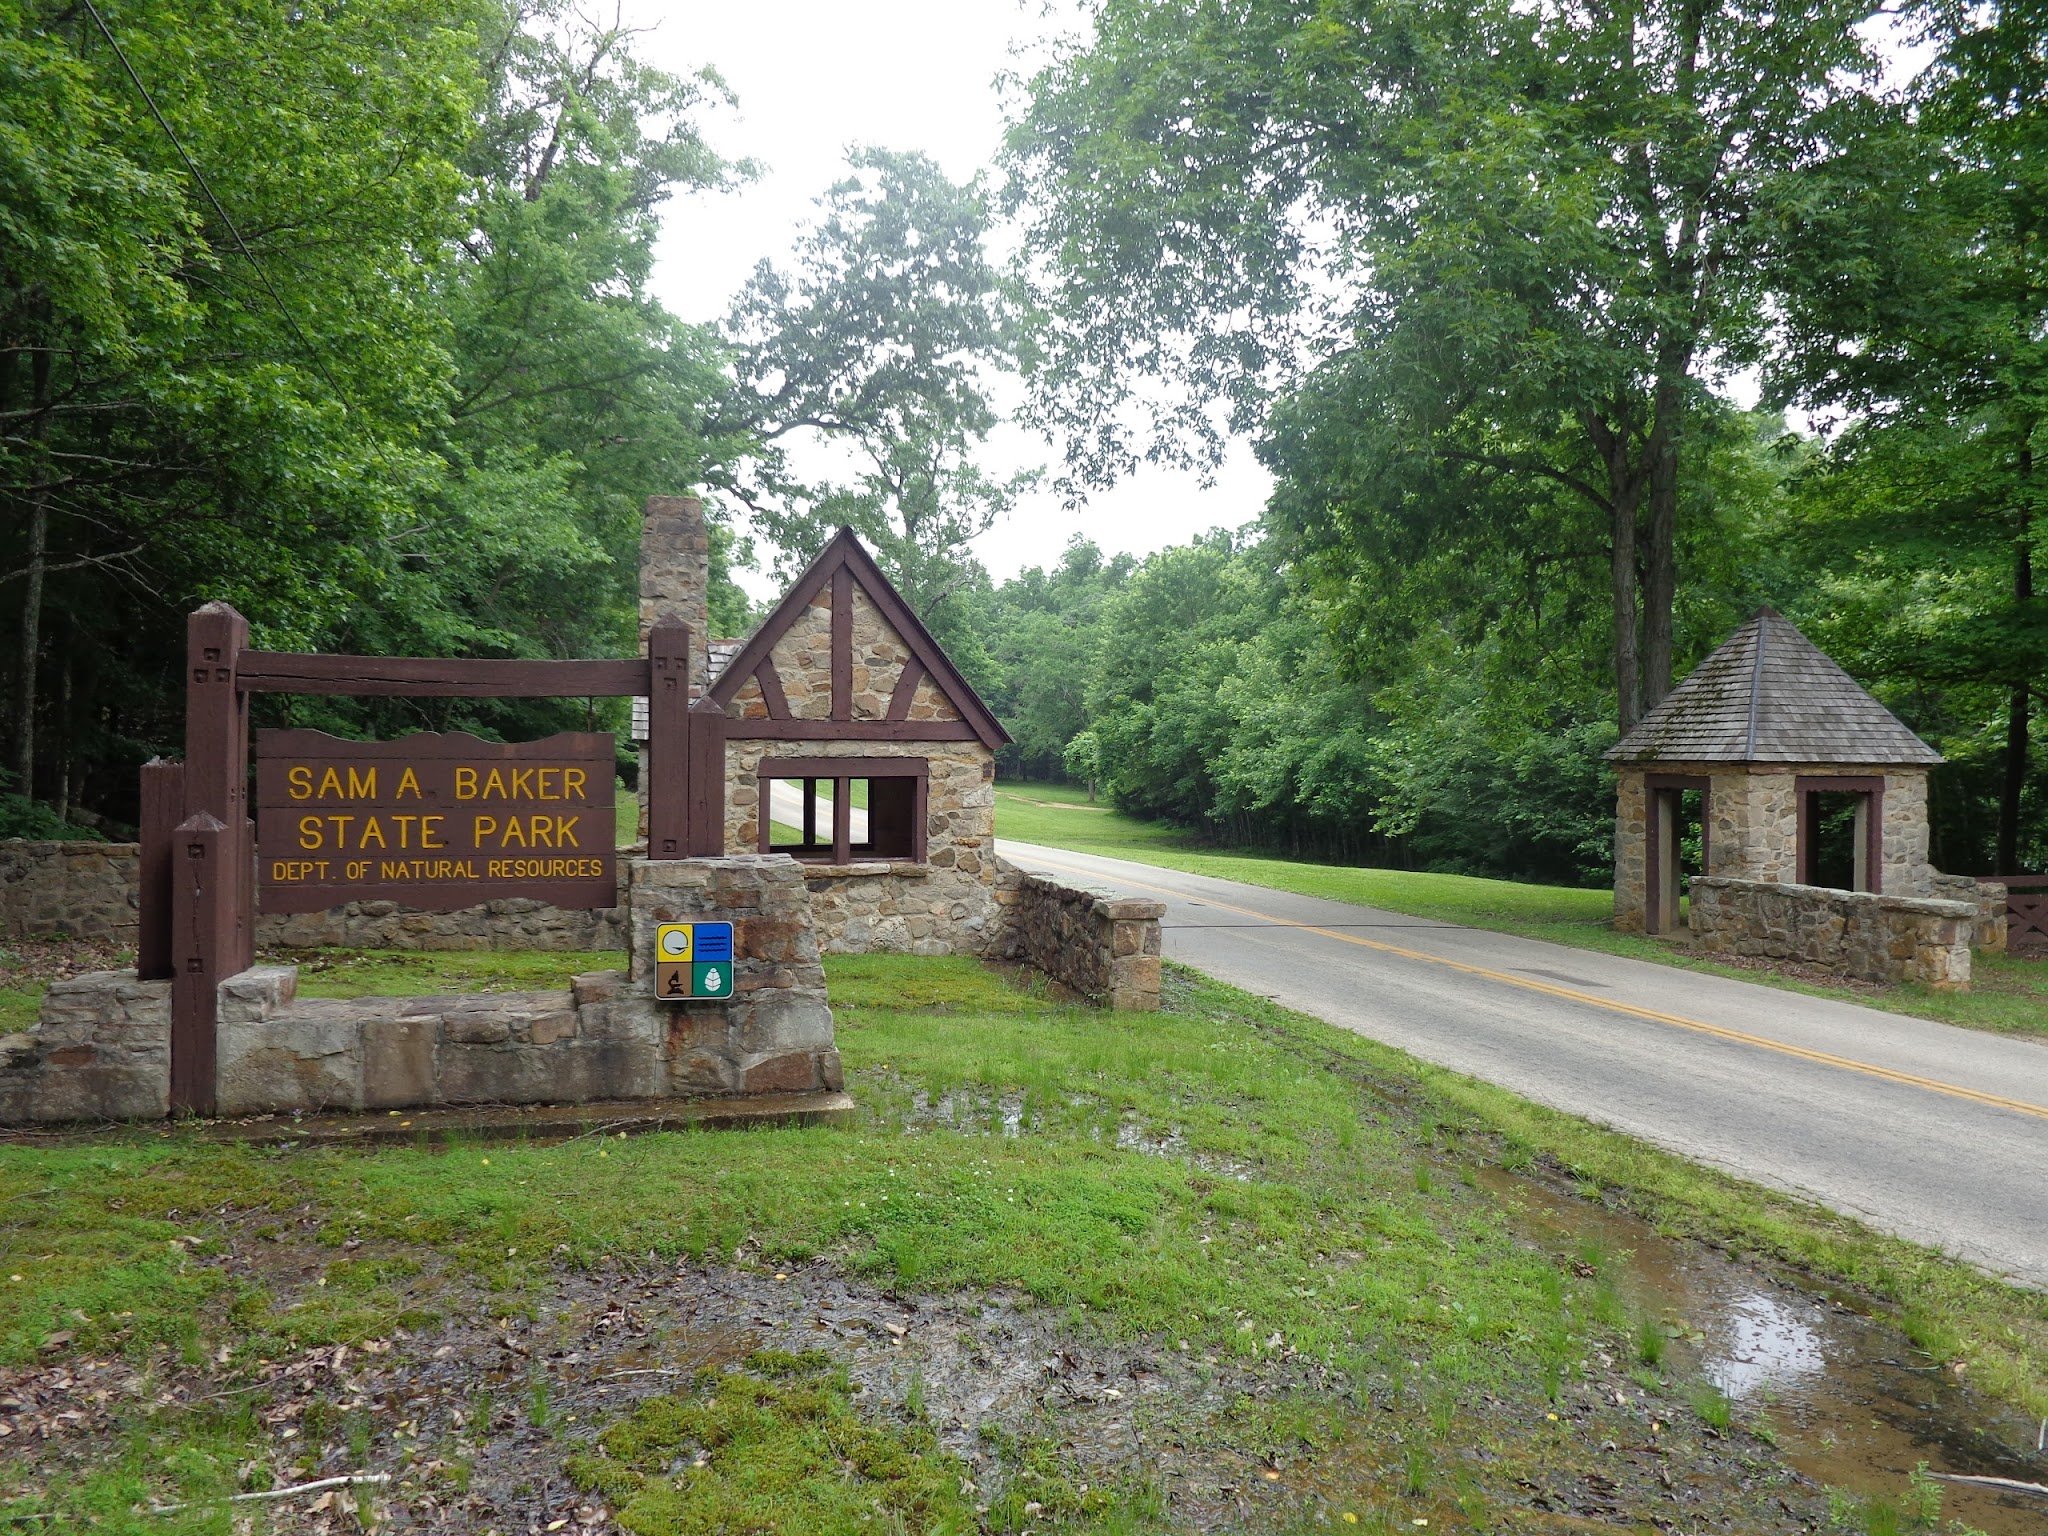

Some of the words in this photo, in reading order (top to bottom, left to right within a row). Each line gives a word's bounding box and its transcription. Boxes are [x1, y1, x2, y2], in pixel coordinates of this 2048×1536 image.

[288, 766, 378, 800] SAM
[396, 767, 423, 800] A
[455, 767, 587, 800] BAKER
[299, 815, 445, 850] STATE
[474, 815, 580, 849] PARK
[273, 861, 337, 881] DEPT.
[346, 860, 370, 880] OF
[381, 860, 480, 880] NATURAL
[488, 858, 603, 878] RESOURCES
